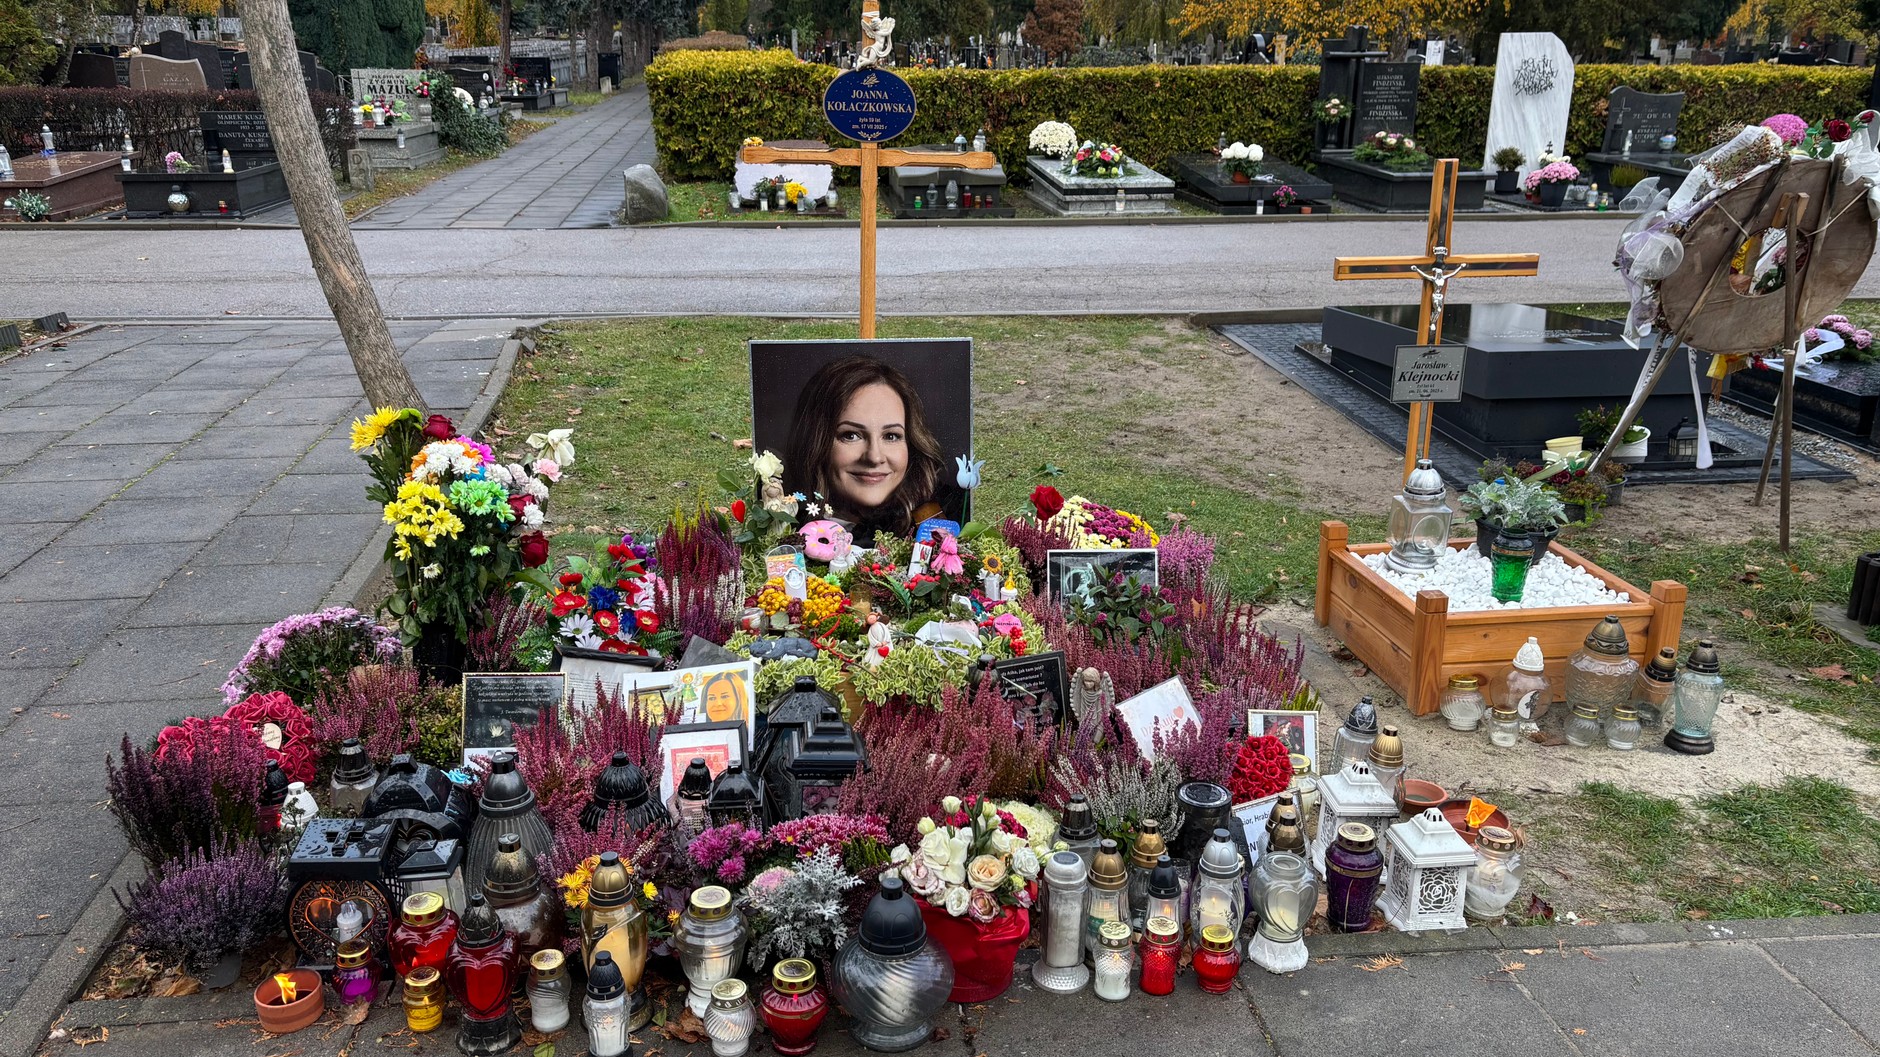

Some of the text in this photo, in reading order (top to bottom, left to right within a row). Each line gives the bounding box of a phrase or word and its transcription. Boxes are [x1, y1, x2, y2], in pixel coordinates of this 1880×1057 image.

[367, 85, 413, 94] MAZUR
[851, 90, 888, 100] JOANNA
[827, 101, 912, 112] KOŁACZKOWSKA
[1412, 361, 1448, 369] Jarosław
[1398, 371, 1460, 384] Klejnocki
